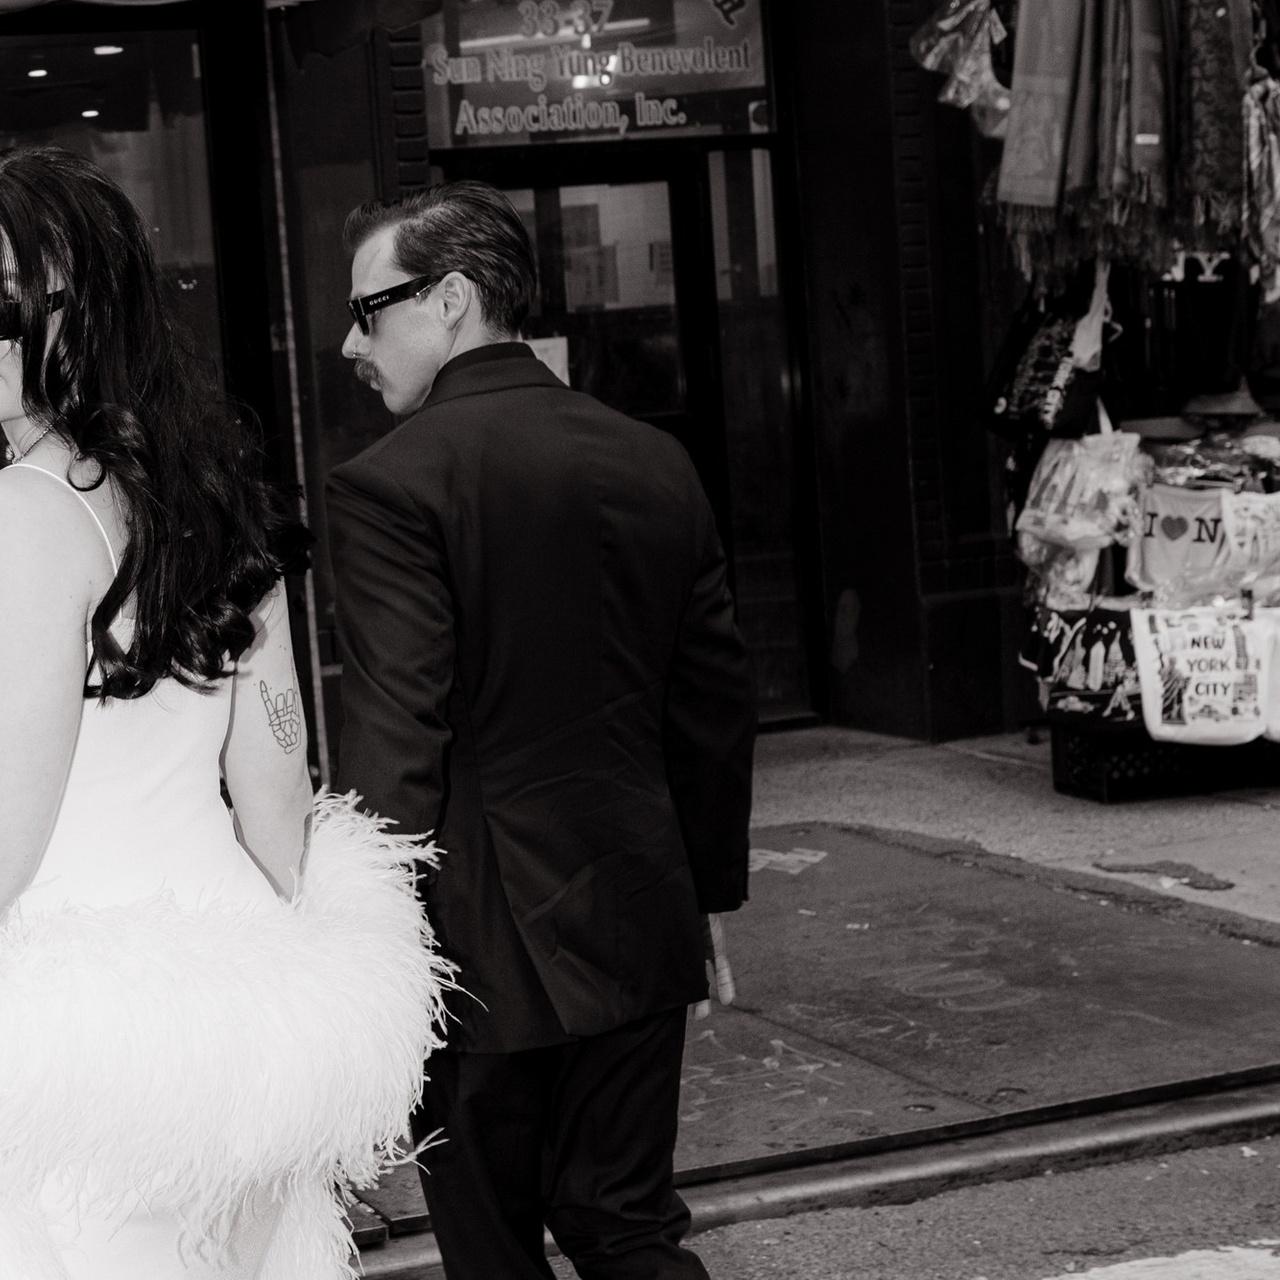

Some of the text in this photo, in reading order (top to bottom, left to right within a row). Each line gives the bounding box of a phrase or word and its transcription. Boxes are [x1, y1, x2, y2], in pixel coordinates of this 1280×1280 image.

[518, 0, 614, 36] 33-37
[431, 47, 481, 84] Sun
[486, 47, 546, 92] Ning
[618, 37, 750, 77] Benevolent
[455, 91, 686, 139] Association, Inc.
[368, 294, 390, 307] GUCCI
[1191, 633, 1225, 649] NEW
[1187, 657, 1230, 672] YORK
[1195, 682, 1231, 696] CITY
